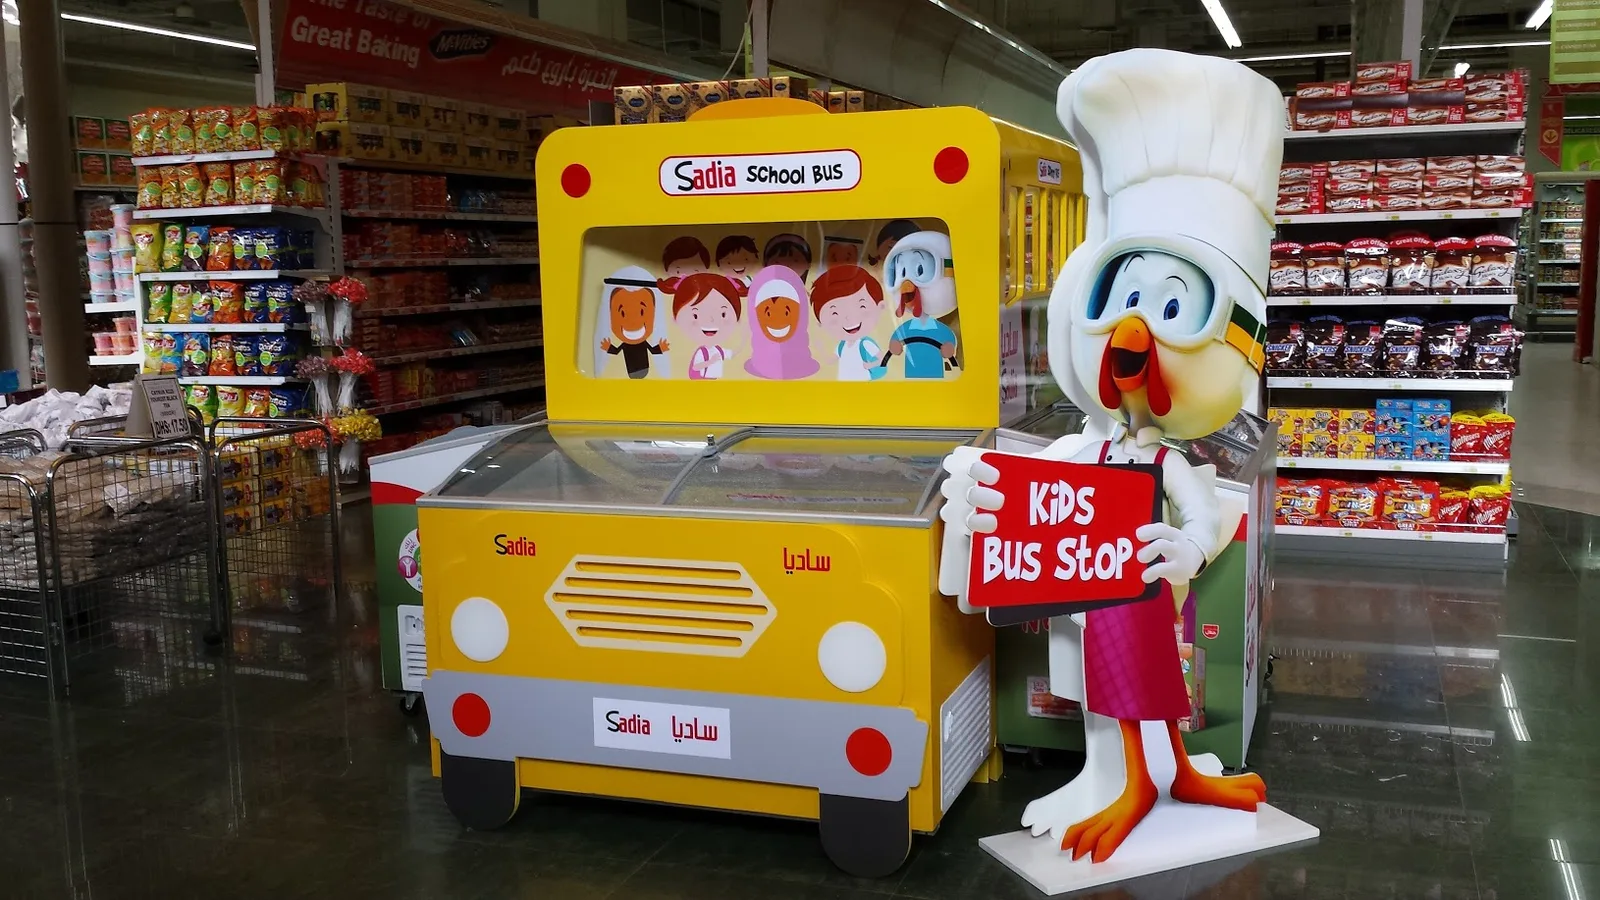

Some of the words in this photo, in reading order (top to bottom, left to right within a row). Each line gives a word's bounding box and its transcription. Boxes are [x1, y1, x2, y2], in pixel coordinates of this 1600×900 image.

[291, 15, 354, 50] Great
[356, 29, 421, 69] Baking
[1394, 110, 1407, 118] 2+1
[1450, 107, 1464, 115] 2+1
[674, 160, 736, 192] Sadia
[1352, 239, 1370, 248] Great
[1370, 238, 1388, 248] Offer
[1395, 238, 1413, 246] Great
[1413, 237, 1431, 245] Offer
[1434, 239, 1451, 247] Great
[1474, 235, 1493, 244] Great
[1493, 234, 1511, 243] Offer
[1271, 268, 1306, 281] Galaxy
[1307, 267, 1344, 281] Galaxy
[1350, 267, 1388, 281] Galaxy
[1394, 266, 1431, 279] Galaxy
[1433, 266, 1470, 280] Galaxy
[1472, 263, 1512, 278] Galaxy
[258, 342, 283, 352] Doritos
[171, 418, 189, 433] 17.50
[494, 533, 537, 557] Sadia
[783, 547, 831, 575] ساديا
[605, 710, 652, 736] Sadia
[671, 715, 719, 743] ساديا
